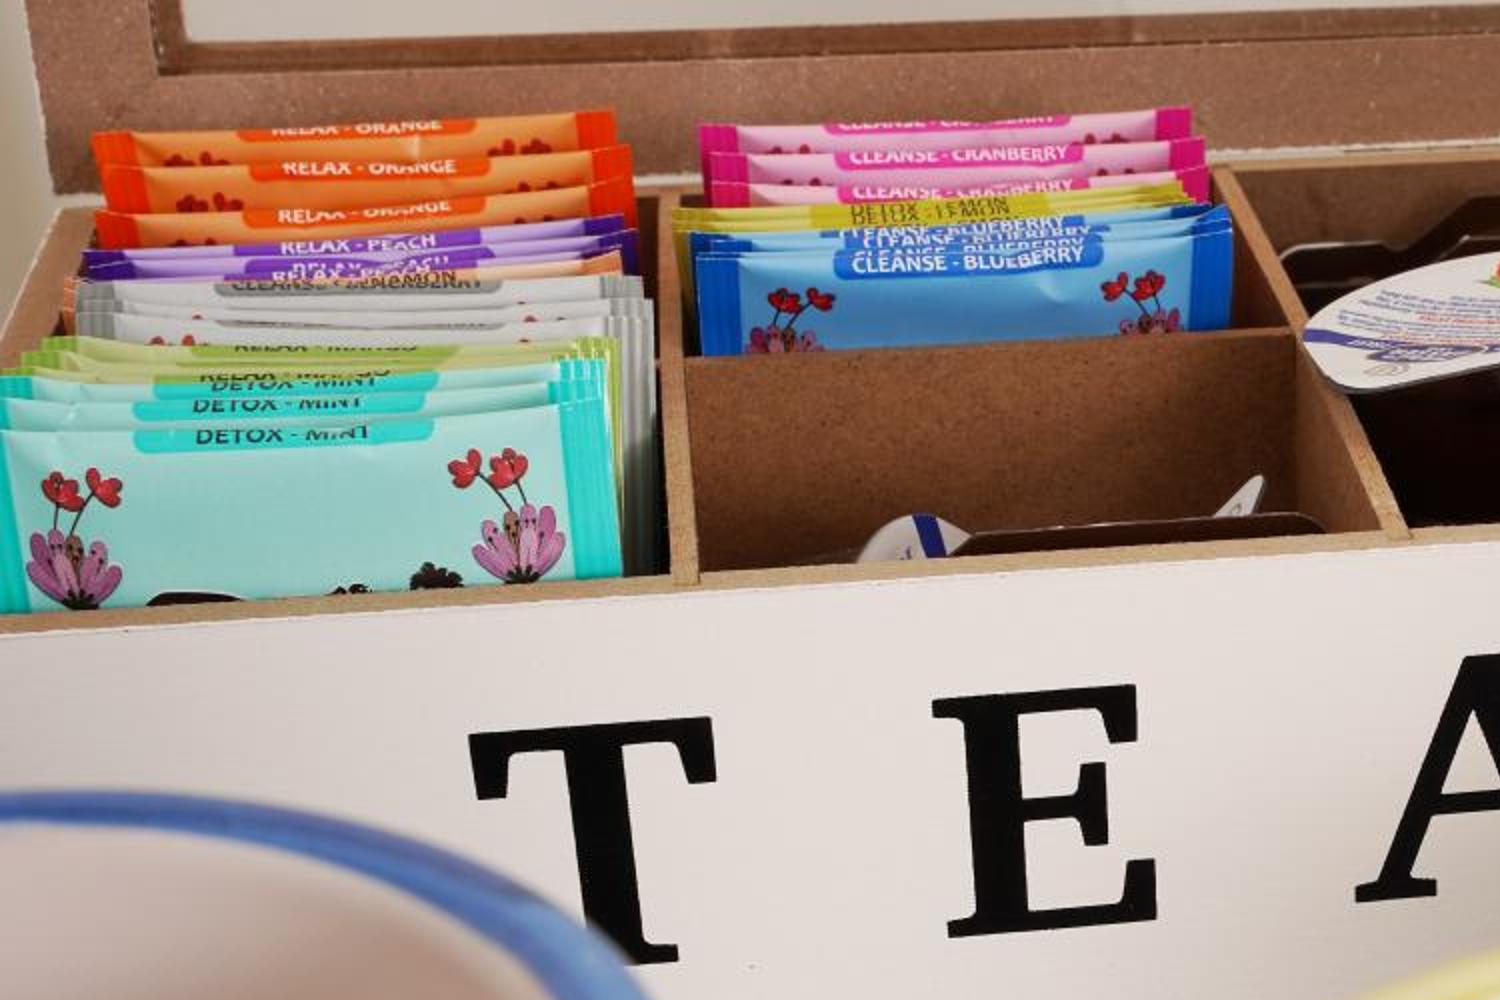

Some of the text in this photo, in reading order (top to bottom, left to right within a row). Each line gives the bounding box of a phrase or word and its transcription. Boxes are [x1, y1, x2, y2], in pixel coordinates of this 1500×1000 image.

[355, 119, 443, 134] ORANGE
[849, 149, 939, 164] CLEANSE
[951, 144, 1068, 164] CRANBERRY
[281, 162, 352, 176] RELAX
[281, 238, 350, 255] RELAX
[852, 255, 948, 274] CLEANSE
[963, 247, 1085, 271] BLUEBERRY
[192, 399, 278, 413] DETOX
[195, 429, 284, 445] DETOX
